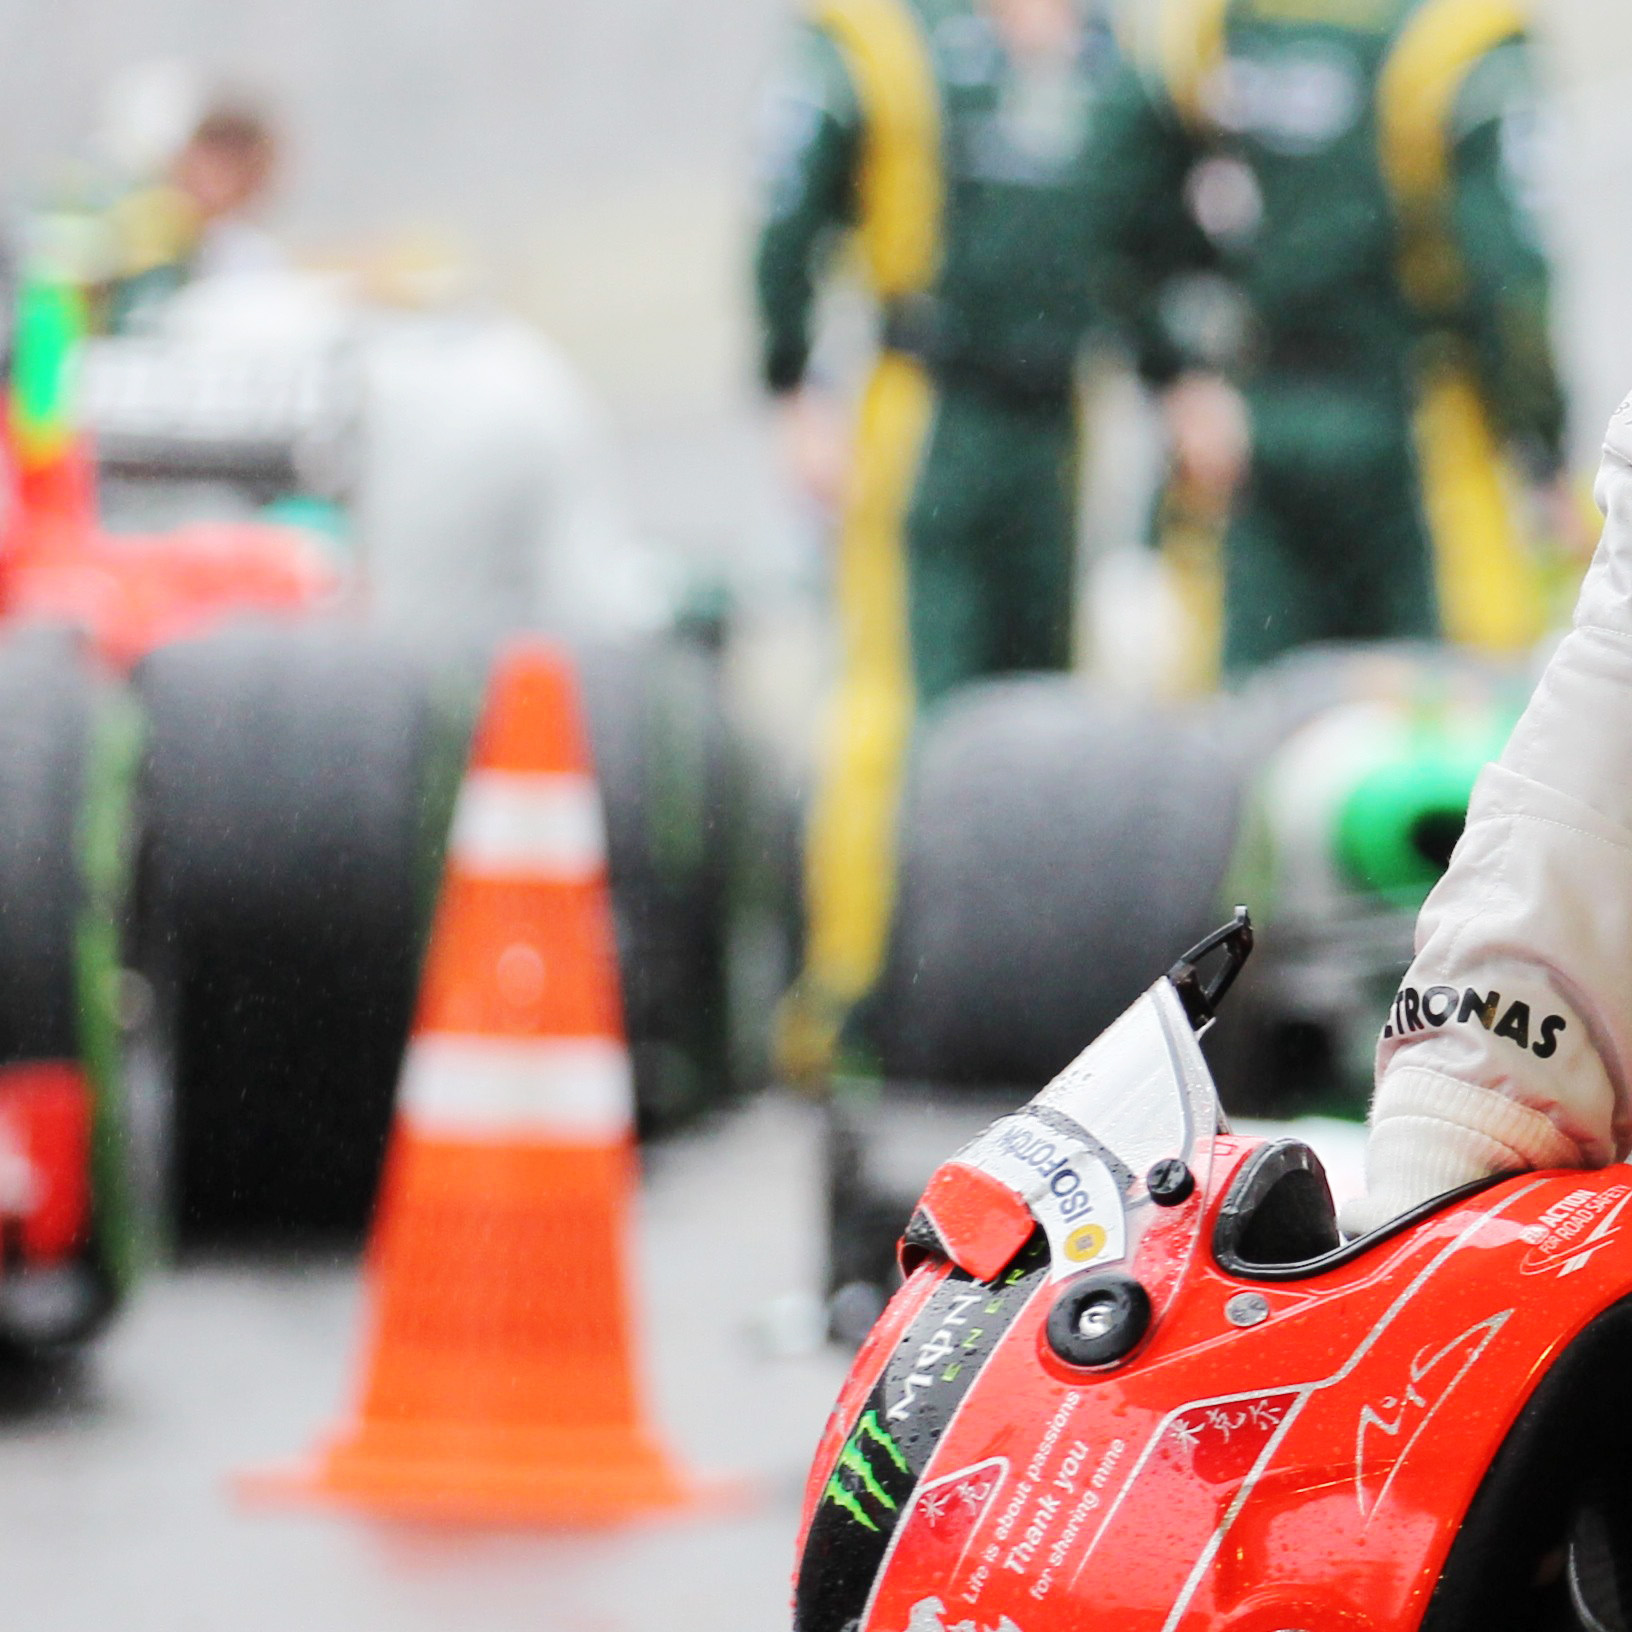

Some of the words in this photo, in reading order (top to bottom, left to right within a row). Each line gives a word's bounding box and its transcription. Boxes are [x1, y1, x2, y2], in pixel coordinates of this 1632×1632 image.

[1384, 986, 1566, 1059] TRONAS
[1538, 1188, 1600, 1230] ACTION
[1539, 1232, 1562, 1254] FOR
[1559, 1209, 1596, 1244] ROAD
[1588, 1183, 1631, 1221] SAFETY
[887, 1294, 983, 1421] MON
[961, 1565, 990, 1605] Life
[985, 1544, 1001, 1563] is
[996, 1481, 1033, 1540] about
[1027, 1391, 1081, 1483] passions
[1003, 1494, 1062, 1575] Thank
[1054, 1439, 1090, 1494] you
[1030, 1571, 1053, 1601] for
[1050, 1489, 1098, 1565] sharing
[1095, 1438, 1125, 1489] mine
